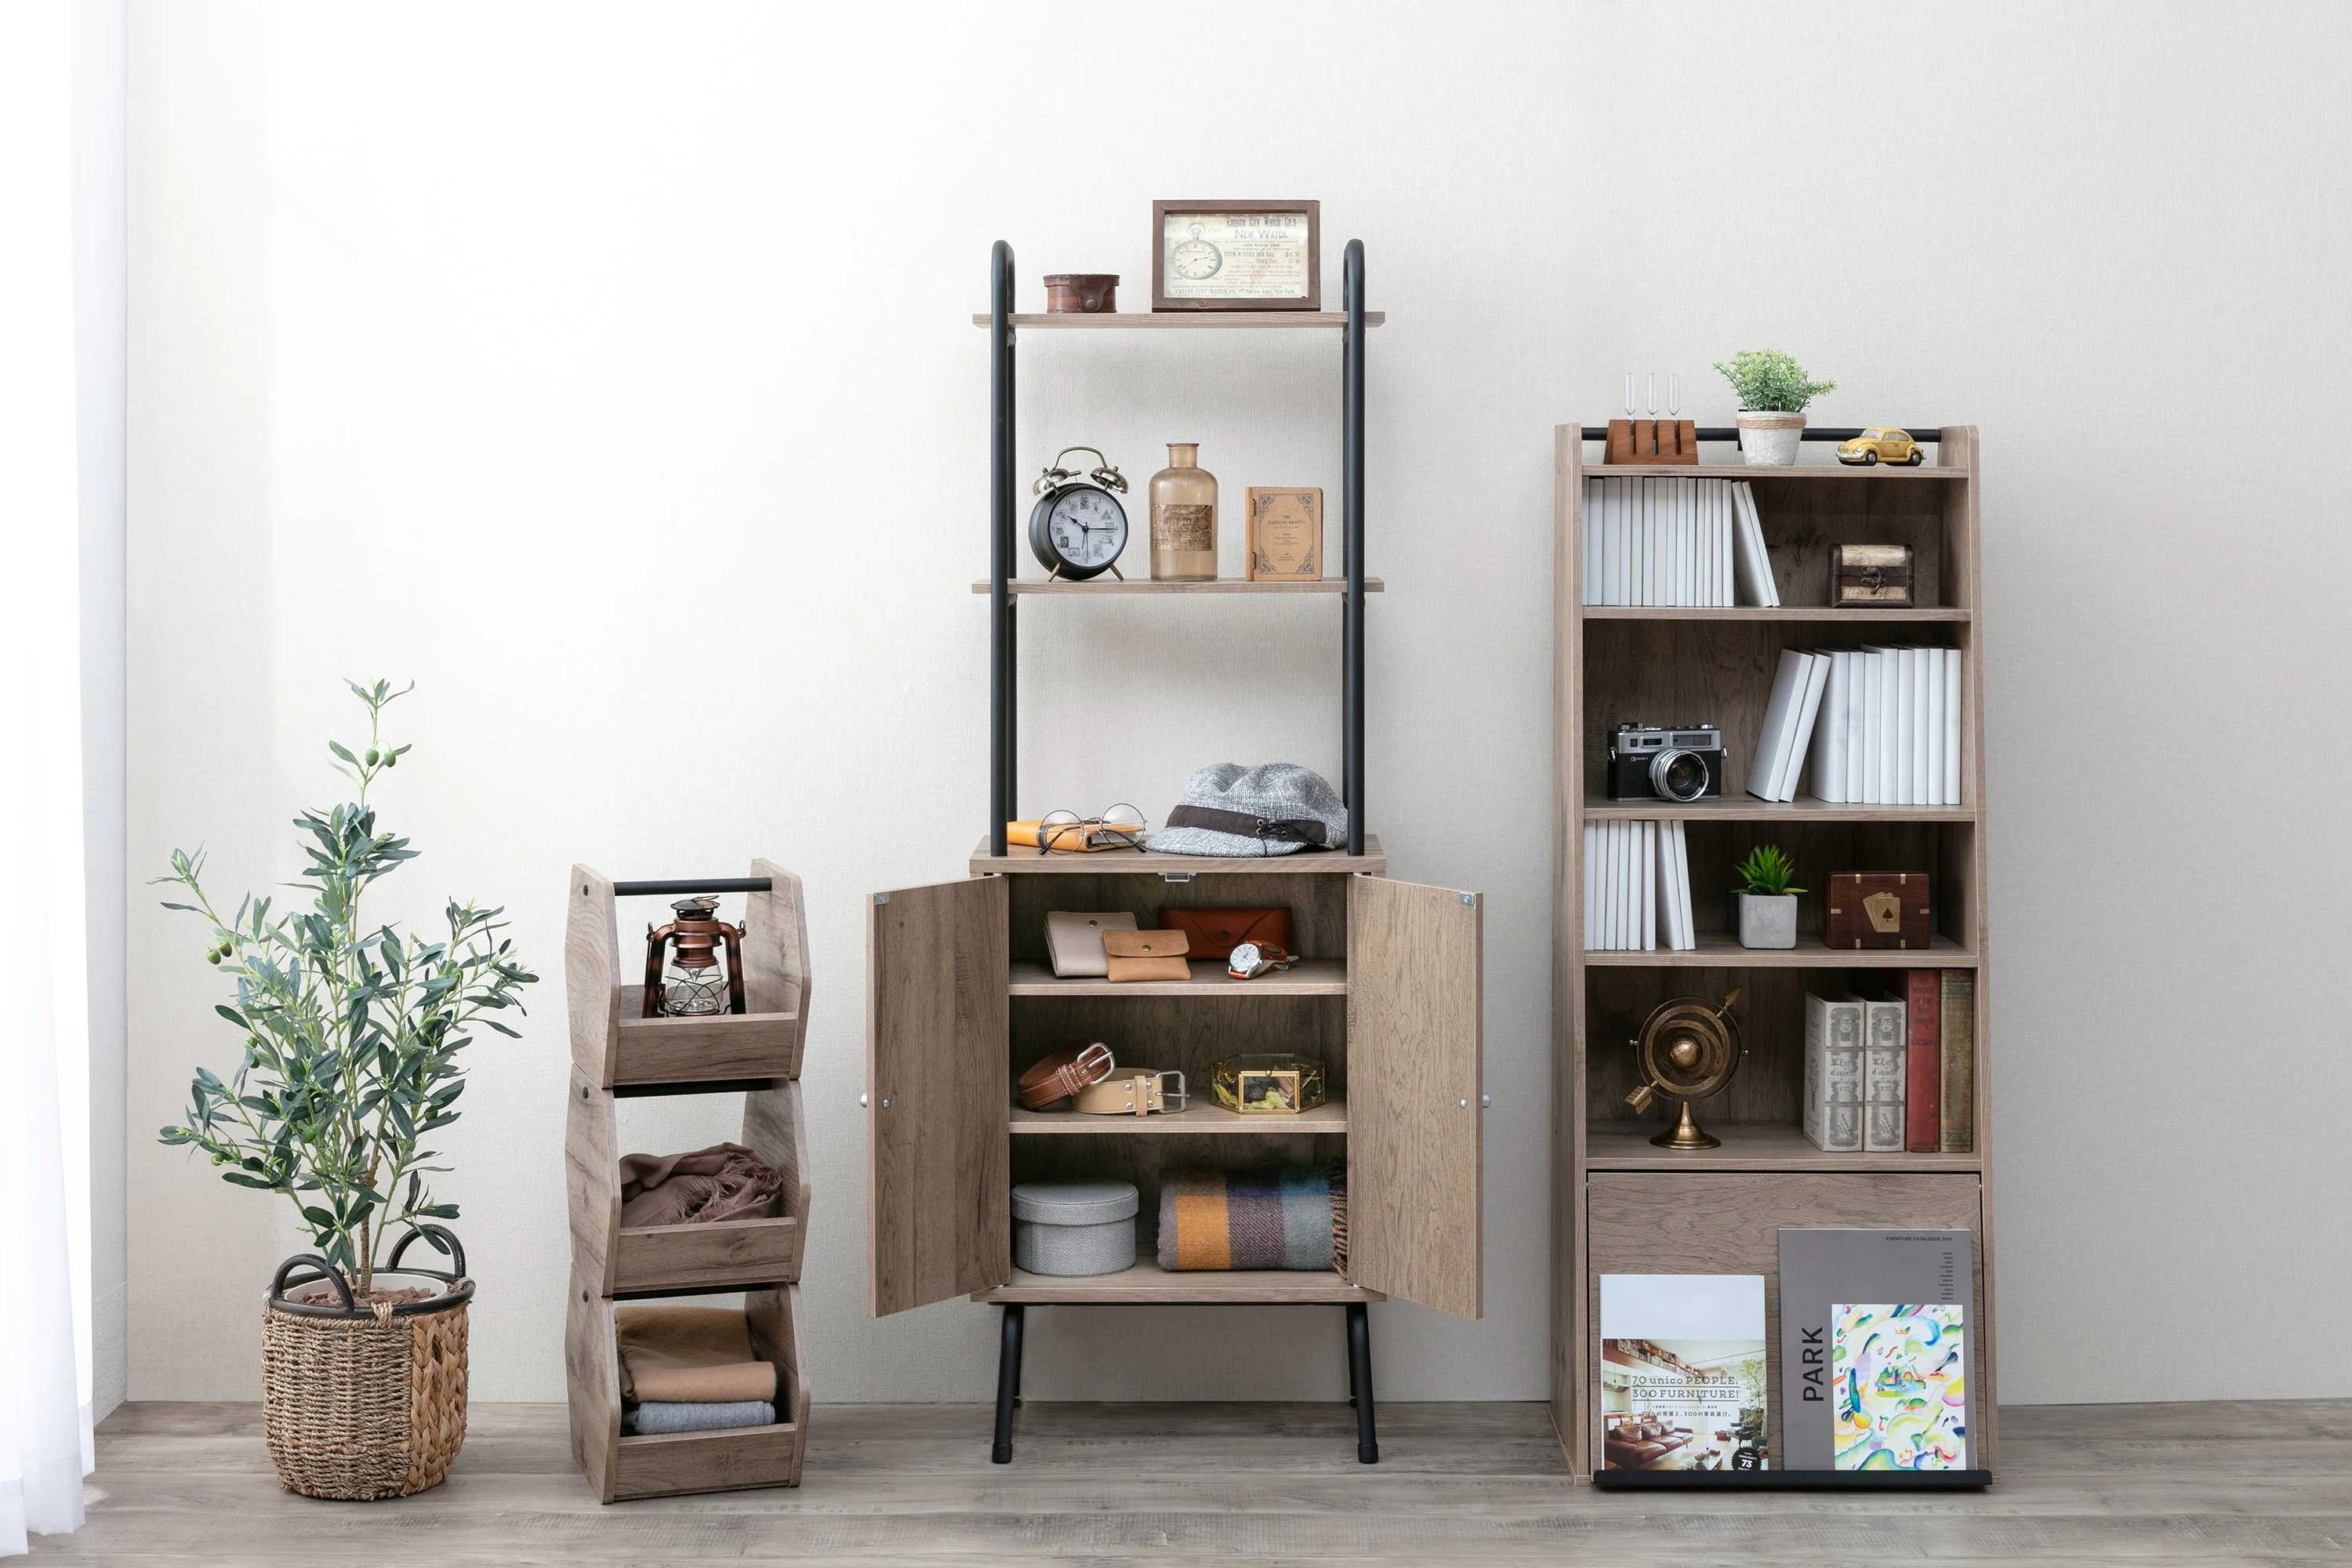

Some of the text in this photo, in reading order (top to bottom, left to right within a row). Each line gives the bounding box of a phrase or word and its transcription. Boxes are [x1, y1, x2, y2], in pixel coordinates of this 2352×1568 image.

[1226, 216, 1246, 228] Empire
[1249, 216, 1261, 228] City
[1264, 216, 1281, 227] Watch
[1802, 1326, 1824, 1401] PARK
[1632, 1375, 1739, 1385] 70 unico PEOPLE,
[1632, 1389, 1739, 1399] 300 FURNITURE!
[1741, 1459, 1753, 1468] 73
